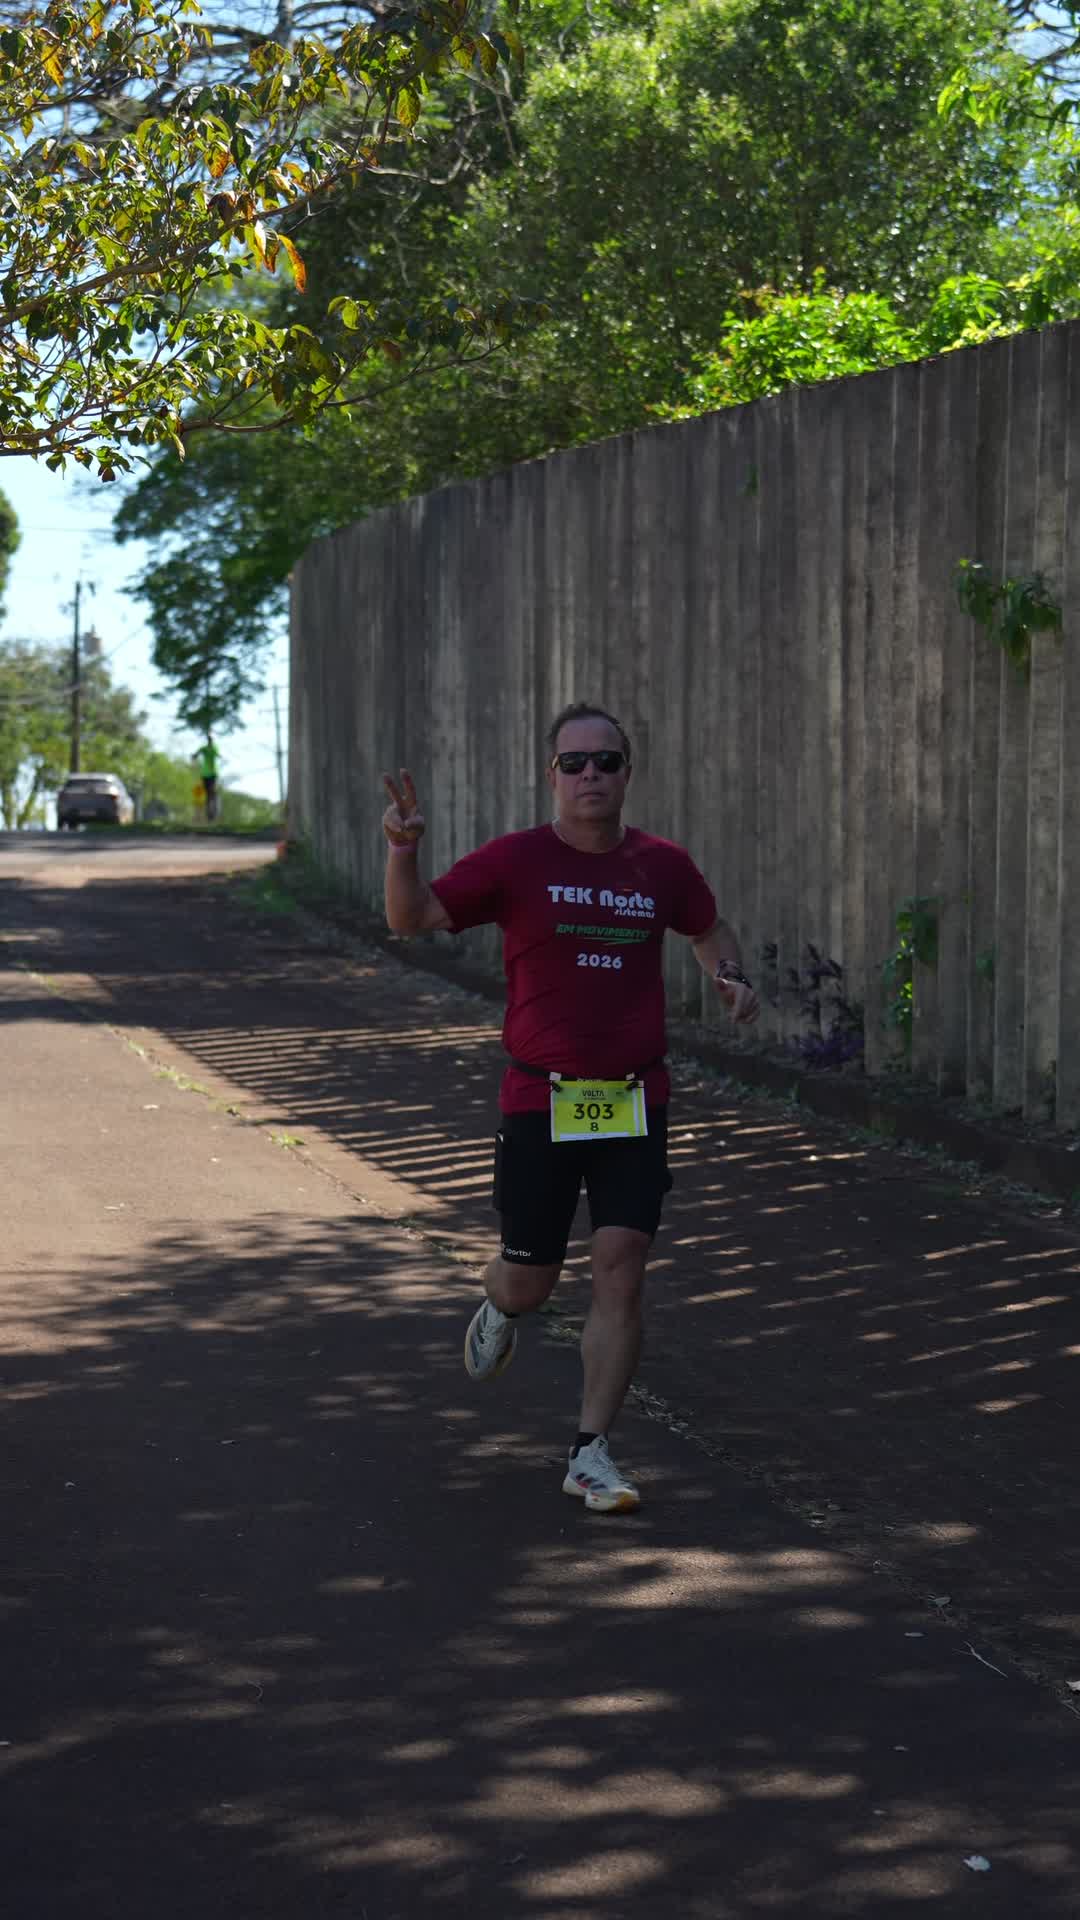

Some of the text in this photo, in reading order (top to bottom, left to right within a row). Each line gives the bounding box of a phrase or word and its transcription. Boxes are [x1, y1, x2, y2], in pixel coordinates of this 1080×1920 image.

[547, 885, 655, 910] TEK Norte
[614, 908, 655, 918] sistemas
[577, 953, 622, 969] 2026
[582, 1089, 604, 1097] VOLTA
[573, 1103, 614, 1120] 303
[590, 1122, 599, 1132] 8
